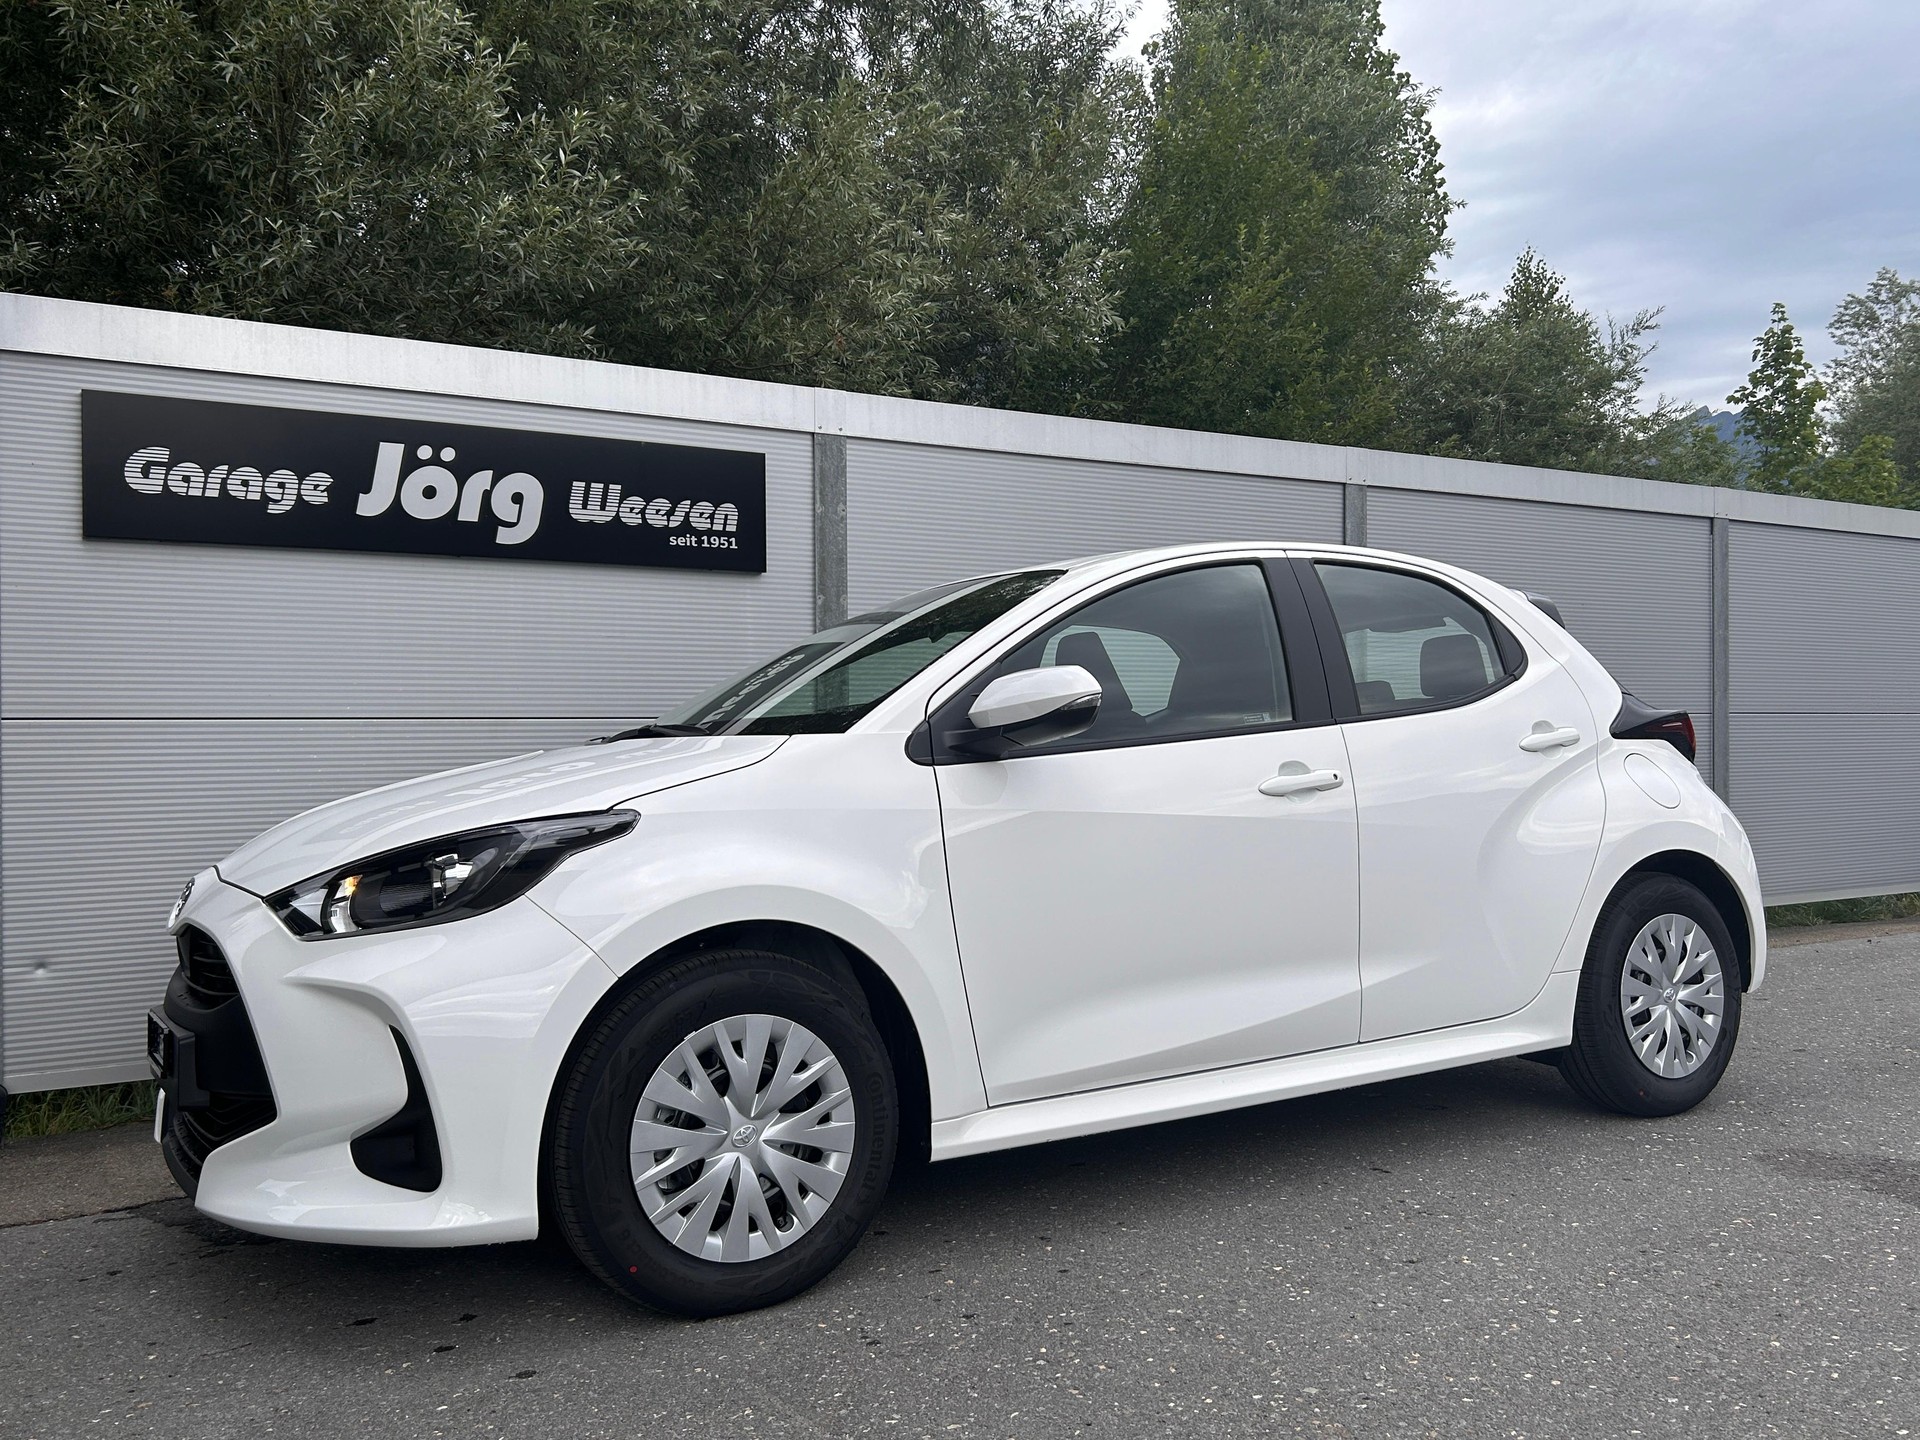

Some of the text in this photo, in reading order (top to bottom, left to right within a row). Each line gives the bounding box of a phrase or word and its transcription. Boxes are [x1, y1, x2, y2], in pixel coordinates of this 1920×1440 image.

[124, 441, 739, 545] Garage Jörg Weesen
[669, 534, 738, 549] seit 1951
